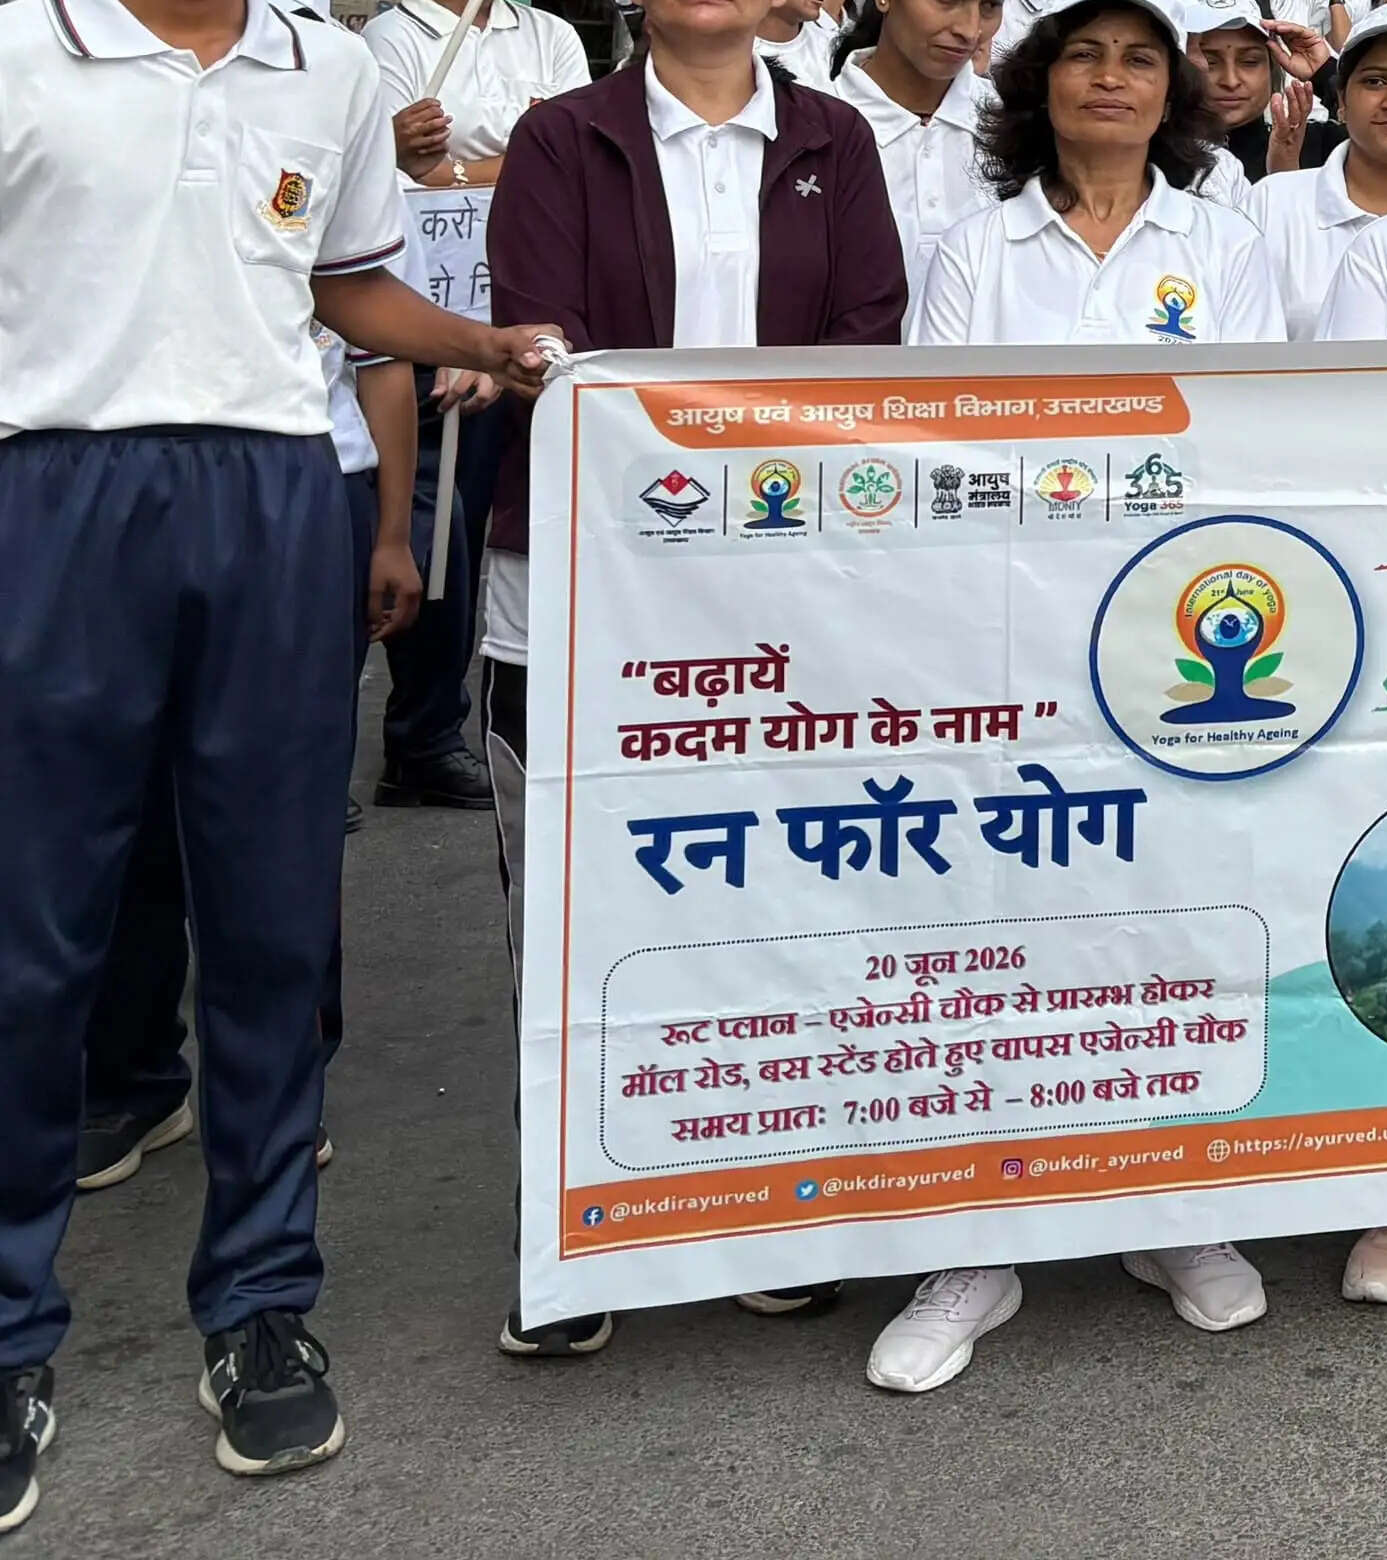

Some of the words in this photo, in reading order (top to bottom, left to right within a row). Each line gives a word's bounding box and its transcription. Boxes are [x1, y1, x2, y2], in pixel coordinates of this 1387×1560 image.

[419, 196, 479, 242] करो
[666, 404, 747, 435] आयुष
[753, 399, 793, 424] एवं
[799, 402, 876, 430] आयुष
[882, 395, 949, 421] शिक्षा
[1042, 394, 1167, 418] उत्तराखण्ड
[967, 490, 1011, 502] मंत्रालय
[968, 471, 1011, 490] आयुष
[1124, 501, 1156, 513] Yoga
[1159, 500, 1184, 511] 365
[1184, 570, 1233, 618] International
[1235, 570, 1256, 585] day
[1256, 579, 1268, 590] of
[1263, 587, 1277, 615] yoga
[618, 716, 750, 761] कदम
[761, 701, 859, 752] योग
[867, 697, 920, 746] के
[931, 704, 1024, 743] नाम
[1151, 734, 1182, 747] Yoga
[1184, 732, 1204, 744] for
[1207, 730, 1254, 745] Healthy
[1257, 727, 1299, 741] Ageing
[626, 810, 760, 895] रन
[776, 774, 958, 880] फॉर
[973, 763, 1148, 868] योग
[866, 953, 897, 981] 20
[905, 949, 957, 986] जून
[965, 945, 1027, 974] 2026
[660, 1019, 711, 1048] रूट
[717, 1010, 798, 1042] प्लान
[829, 997, 933, 1032] एजेन्सी
[940, 986, 1005, 1023] चौक
[1011, 986, 1041, 1013] से
[1048, 982, 1135, 1013] प्रारम्भ
[1141, 975, 1217, 1004] होकर
[621, 1062, 686, 1100] मॉल
[694, 1055, 750, 1092] रोड,
[759, 1055, 811, 1084] बस
[817, 1043, 877, 1078] स्टेंड
[883, 1037, 939, 1072] होते
[944, 1040, 985, 1075] हुए
[991, 1030, 1073, 1060] वापस
[1080, 1017, 1177, 1055] एजेन्सी
[1184, 1011, 1247, 1044] चौक
[671, 1113, 750, 1143] समय
[756, 1103, 827, 1135] प्रातः
[843, 1094, 901, 1124] 7:00
[907, 1088, 957, 1120] बजे
[963, 1080, 994, 1115] से
[1028, 1078, 1087, 1108] 8:00
[1091, 1073, 1141, 1103] बजे
[1146, 1068, 1203, 1096] तक
[822, 1164, 976, 1197] @ukdirayurved
[1029, 1144, 1185, 1177] @ukdir_ayurved
[610, 1186, 769, 1221] @ukdirayurved
